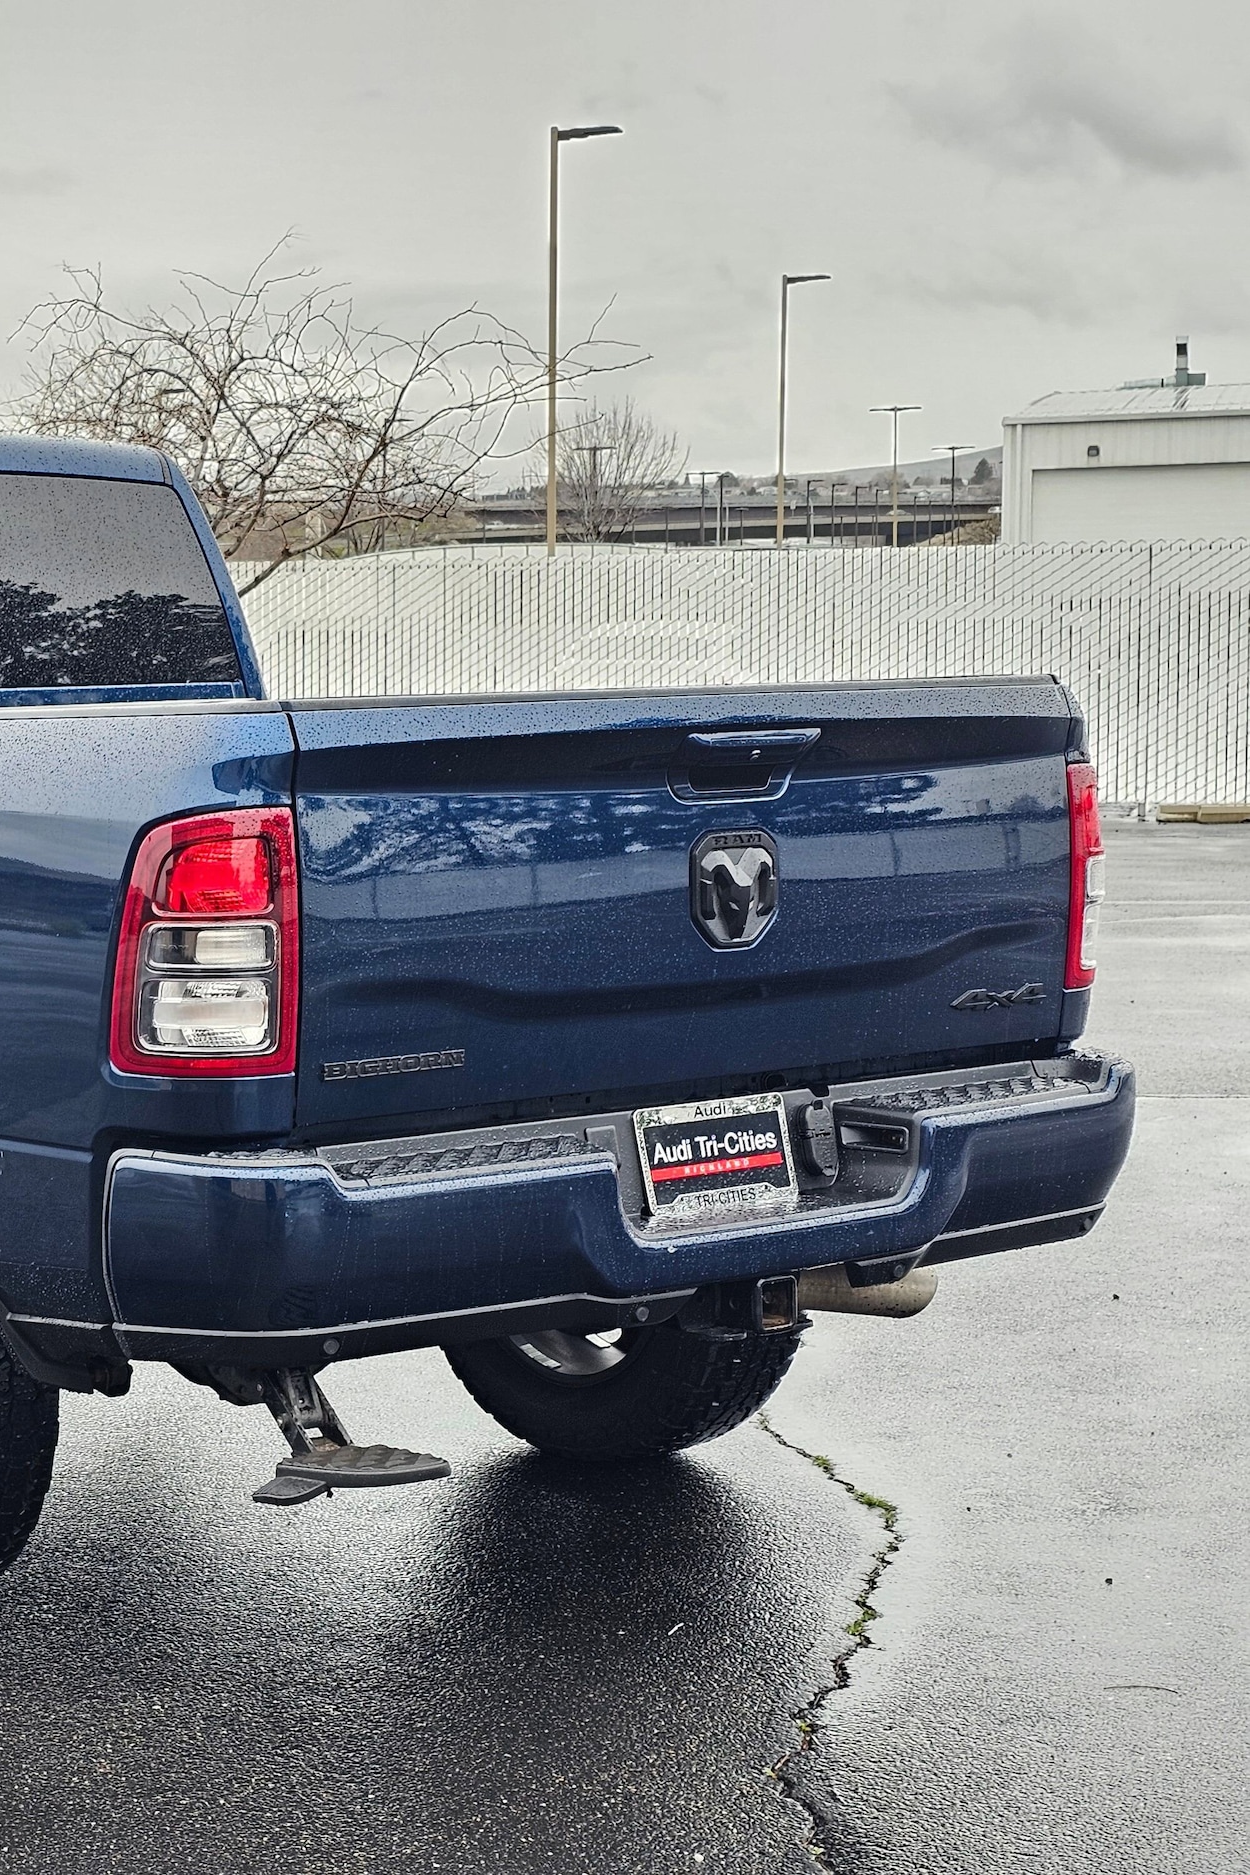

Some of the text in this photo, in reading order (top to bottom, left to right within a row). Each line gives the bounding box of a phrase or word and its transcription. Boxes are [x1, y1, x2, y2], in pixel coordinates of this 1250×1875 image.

[713, 833, 762, 846] RAM
[322, 1049, 466, 1081] BIGHORN
[693, 1103, 726, 1119] Audi
[653, 1129, 778, 1165] Audi Tri-Cities
[684, 1158, 749, 1174] RICHLAND
